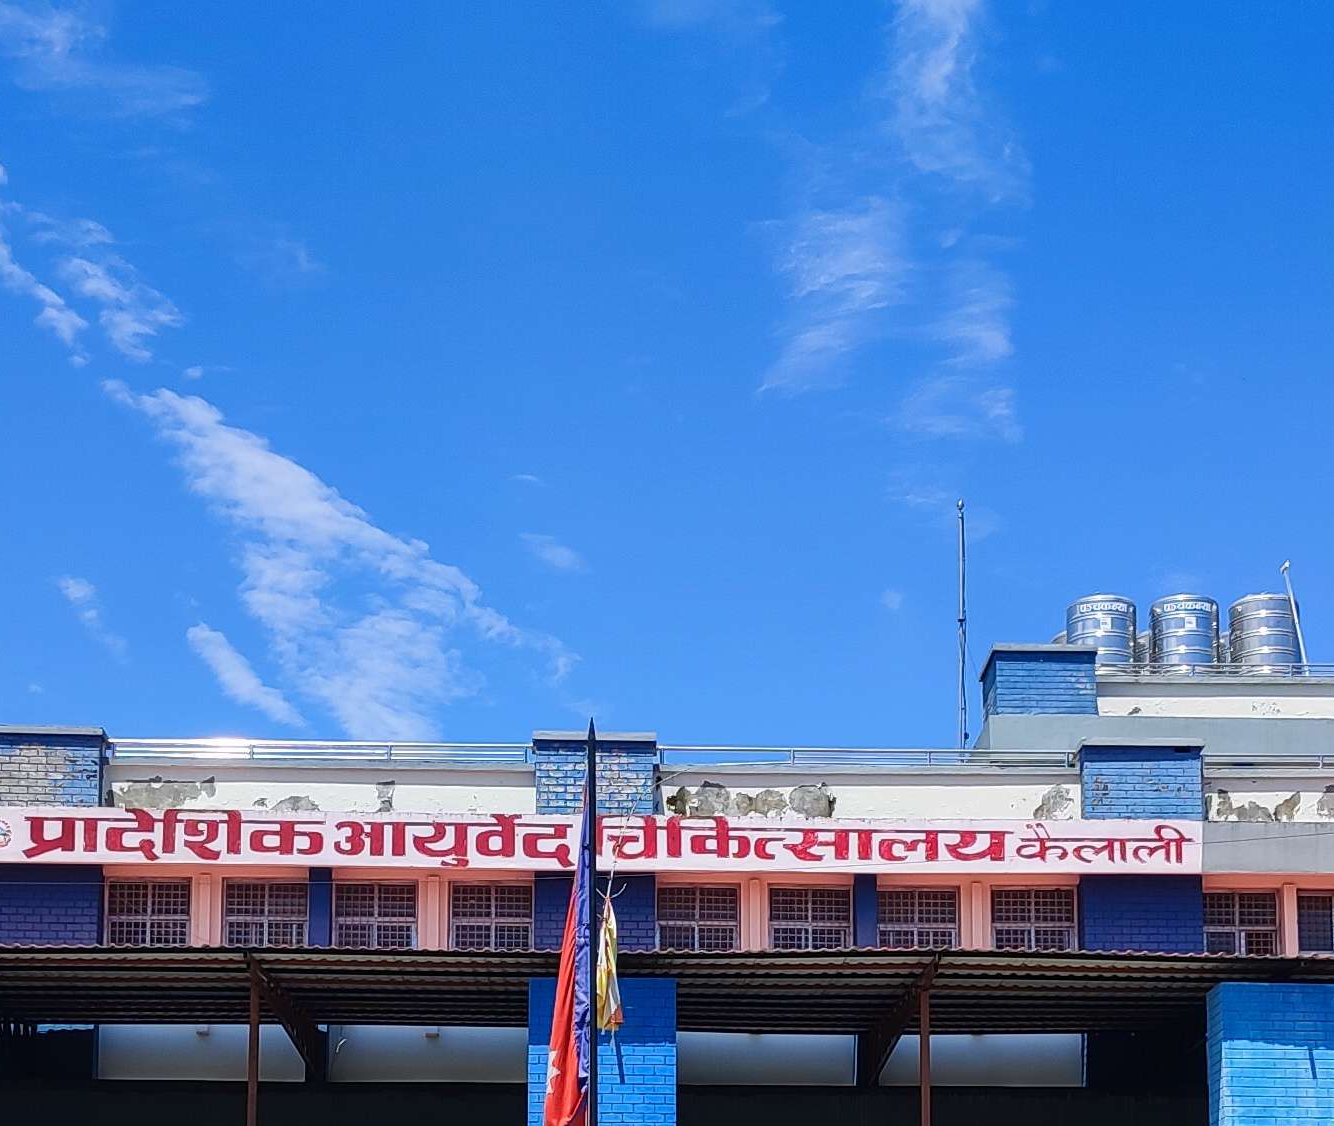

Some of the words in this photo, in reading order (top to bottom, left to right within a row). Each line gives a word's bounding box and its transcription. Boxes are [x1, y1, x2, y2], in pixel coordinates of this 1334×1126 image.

[24, 808, 326, 862] प्रादेशिक
[334, 814, 575, 866] आयुर्वेद
[596, 815, 1014, 863] चिकित्सालय
[1016, 823, 1195, 864] कैलाली
